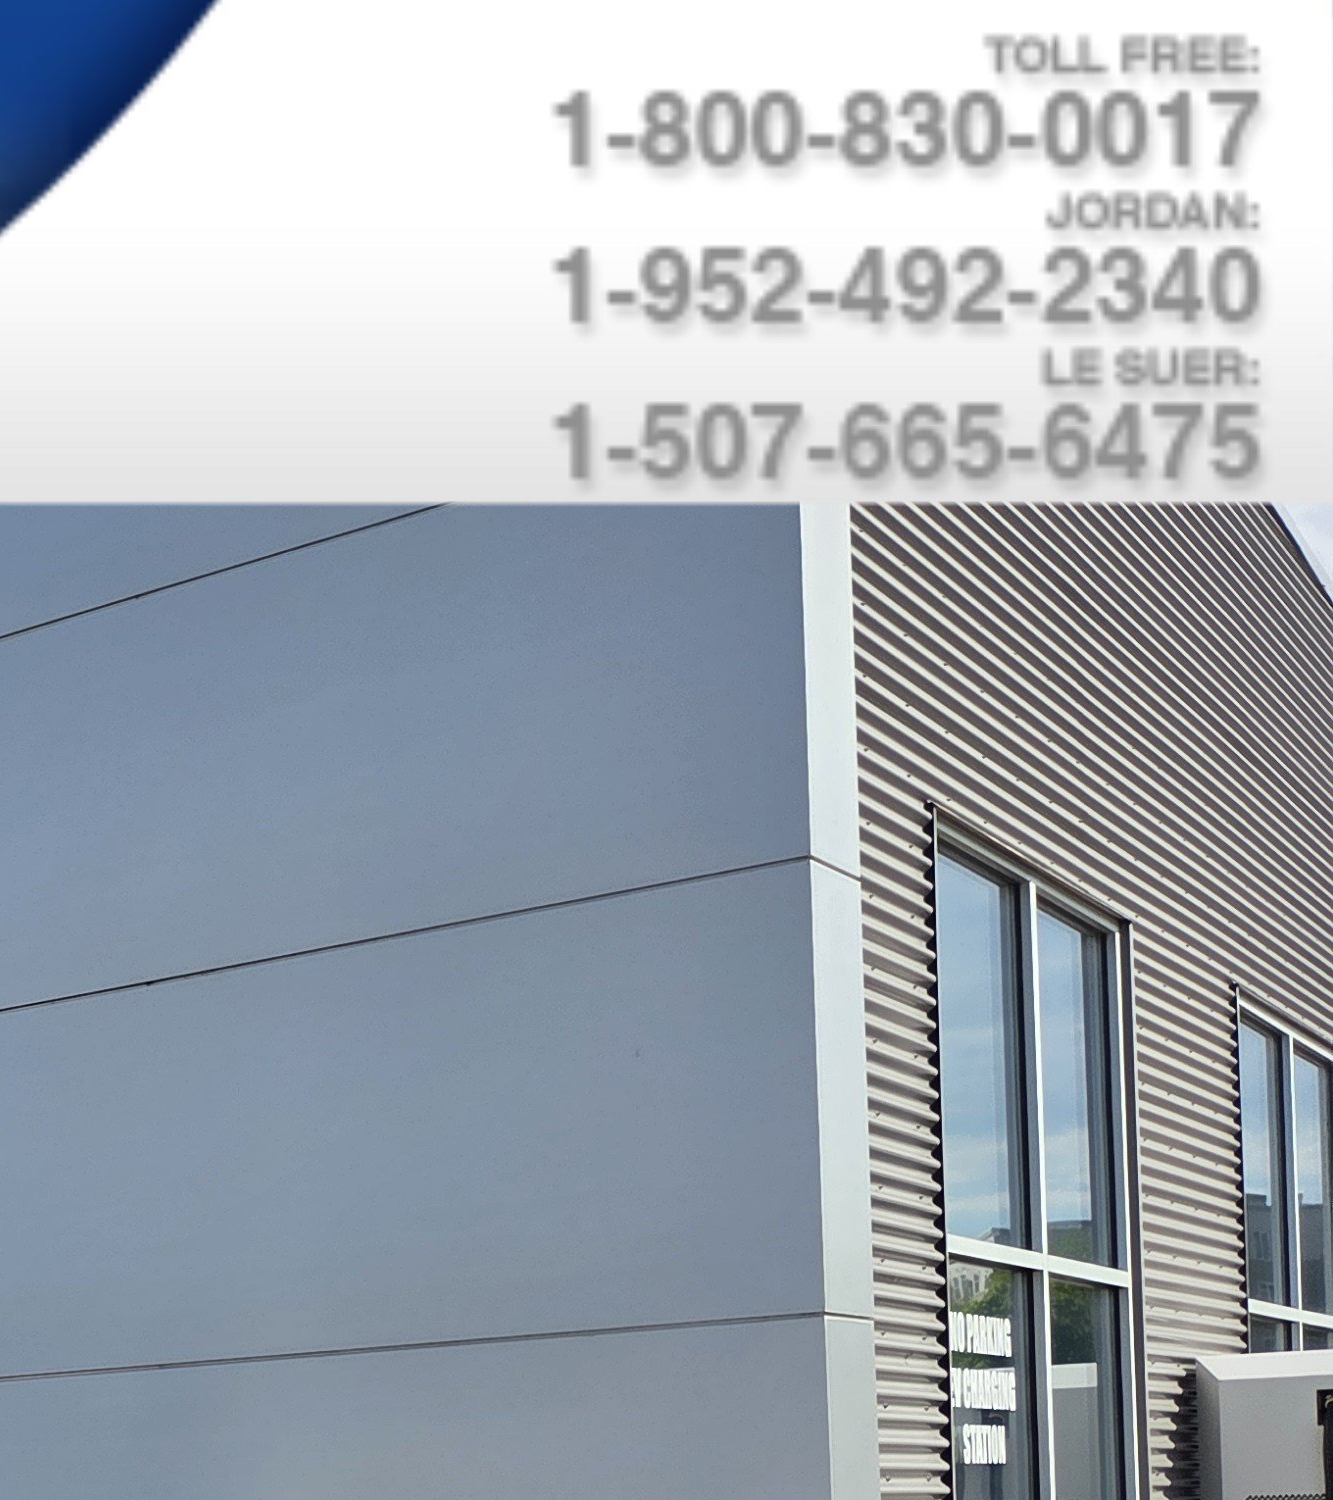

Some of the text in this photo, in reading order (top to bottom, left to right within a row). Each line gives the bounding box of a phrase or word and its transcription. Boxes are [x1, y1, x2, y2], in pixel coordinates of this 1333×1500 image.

[949, 1311, 1012, 1358] NO PARKING
[963, 1367, 1017, 1412] CHARGING
[963, 1423, 1007, 1465] STATION
